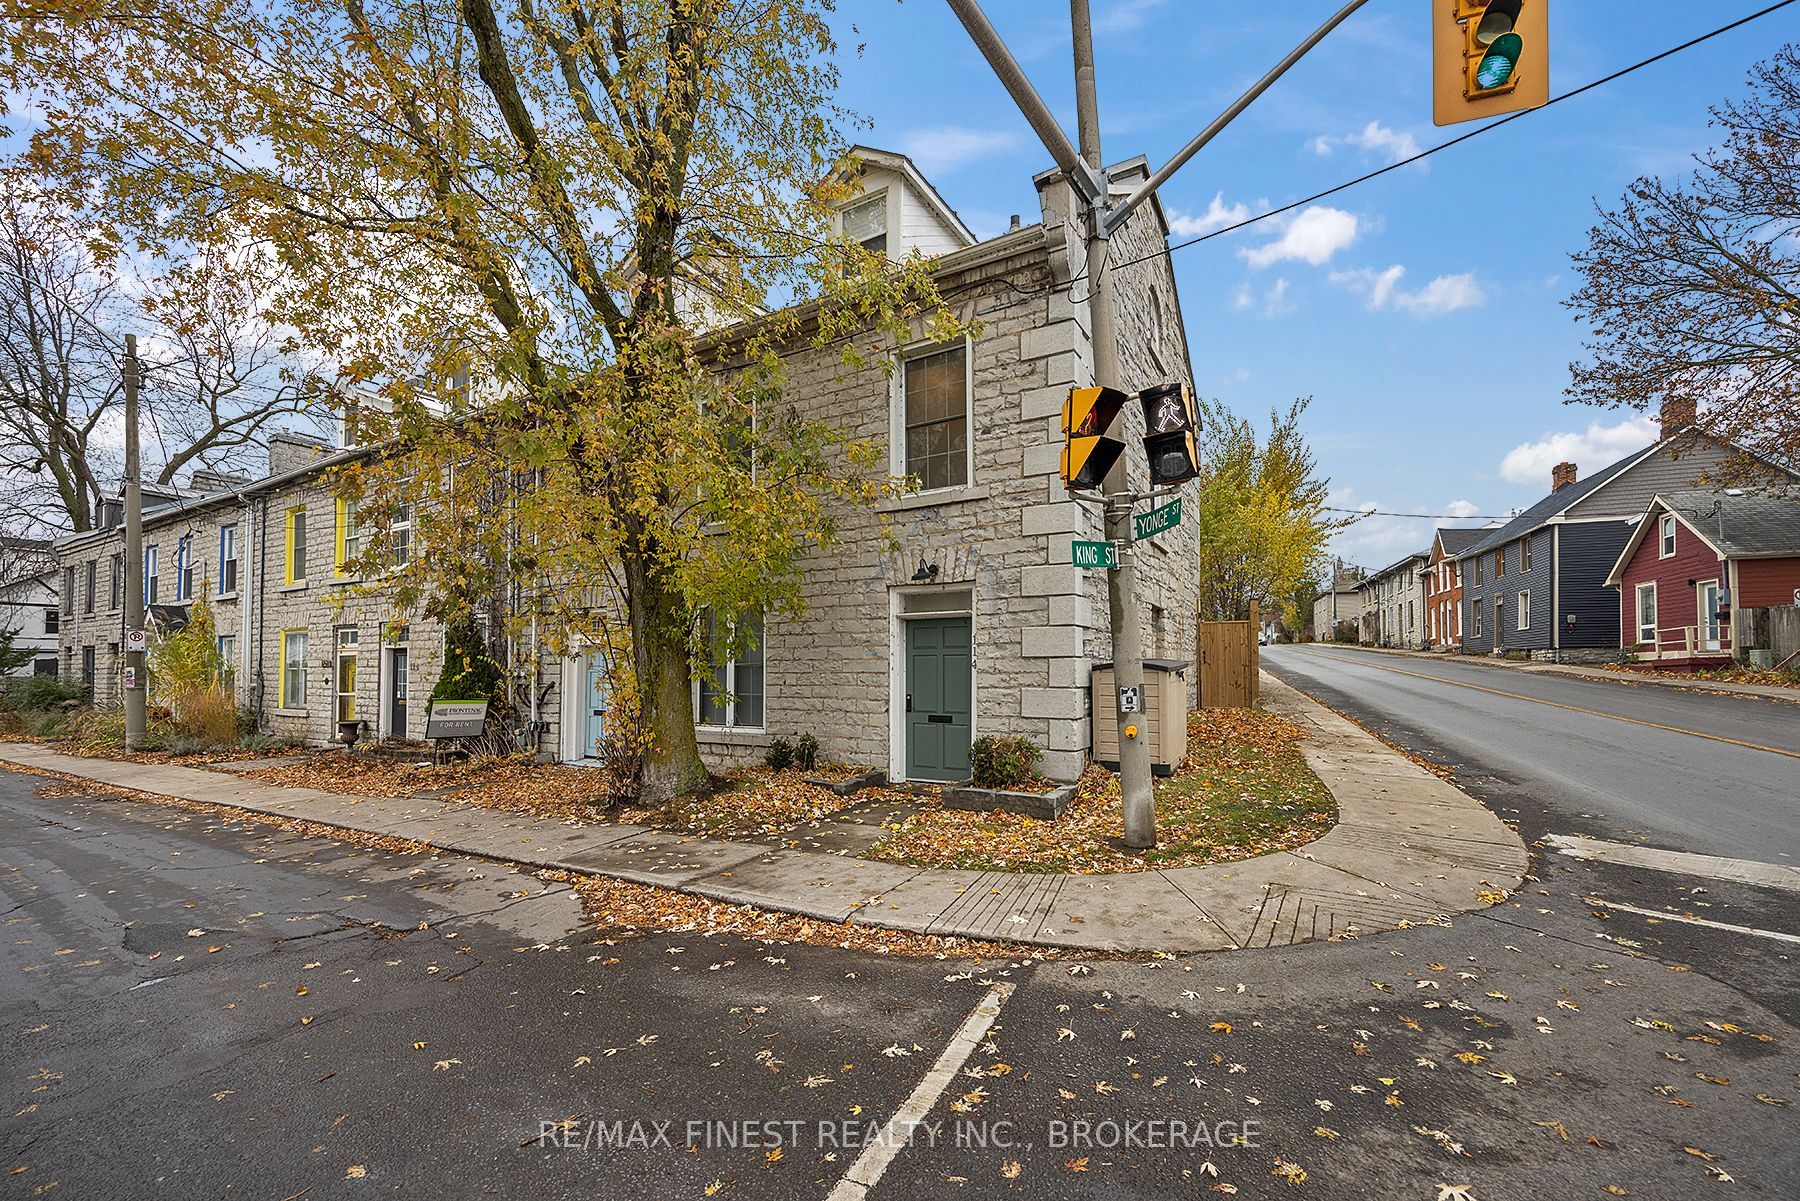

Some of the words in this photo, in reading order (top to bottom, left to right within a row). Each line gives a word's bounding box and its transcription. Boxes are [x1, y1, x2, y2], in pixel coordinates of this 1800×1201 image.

[1139, 508, 1169, 535] YONGE
[1172, 502, 1180, 515] ST
[1076, 545, 1098, 564] KING
[1105, 547, 1115, 565] ST
